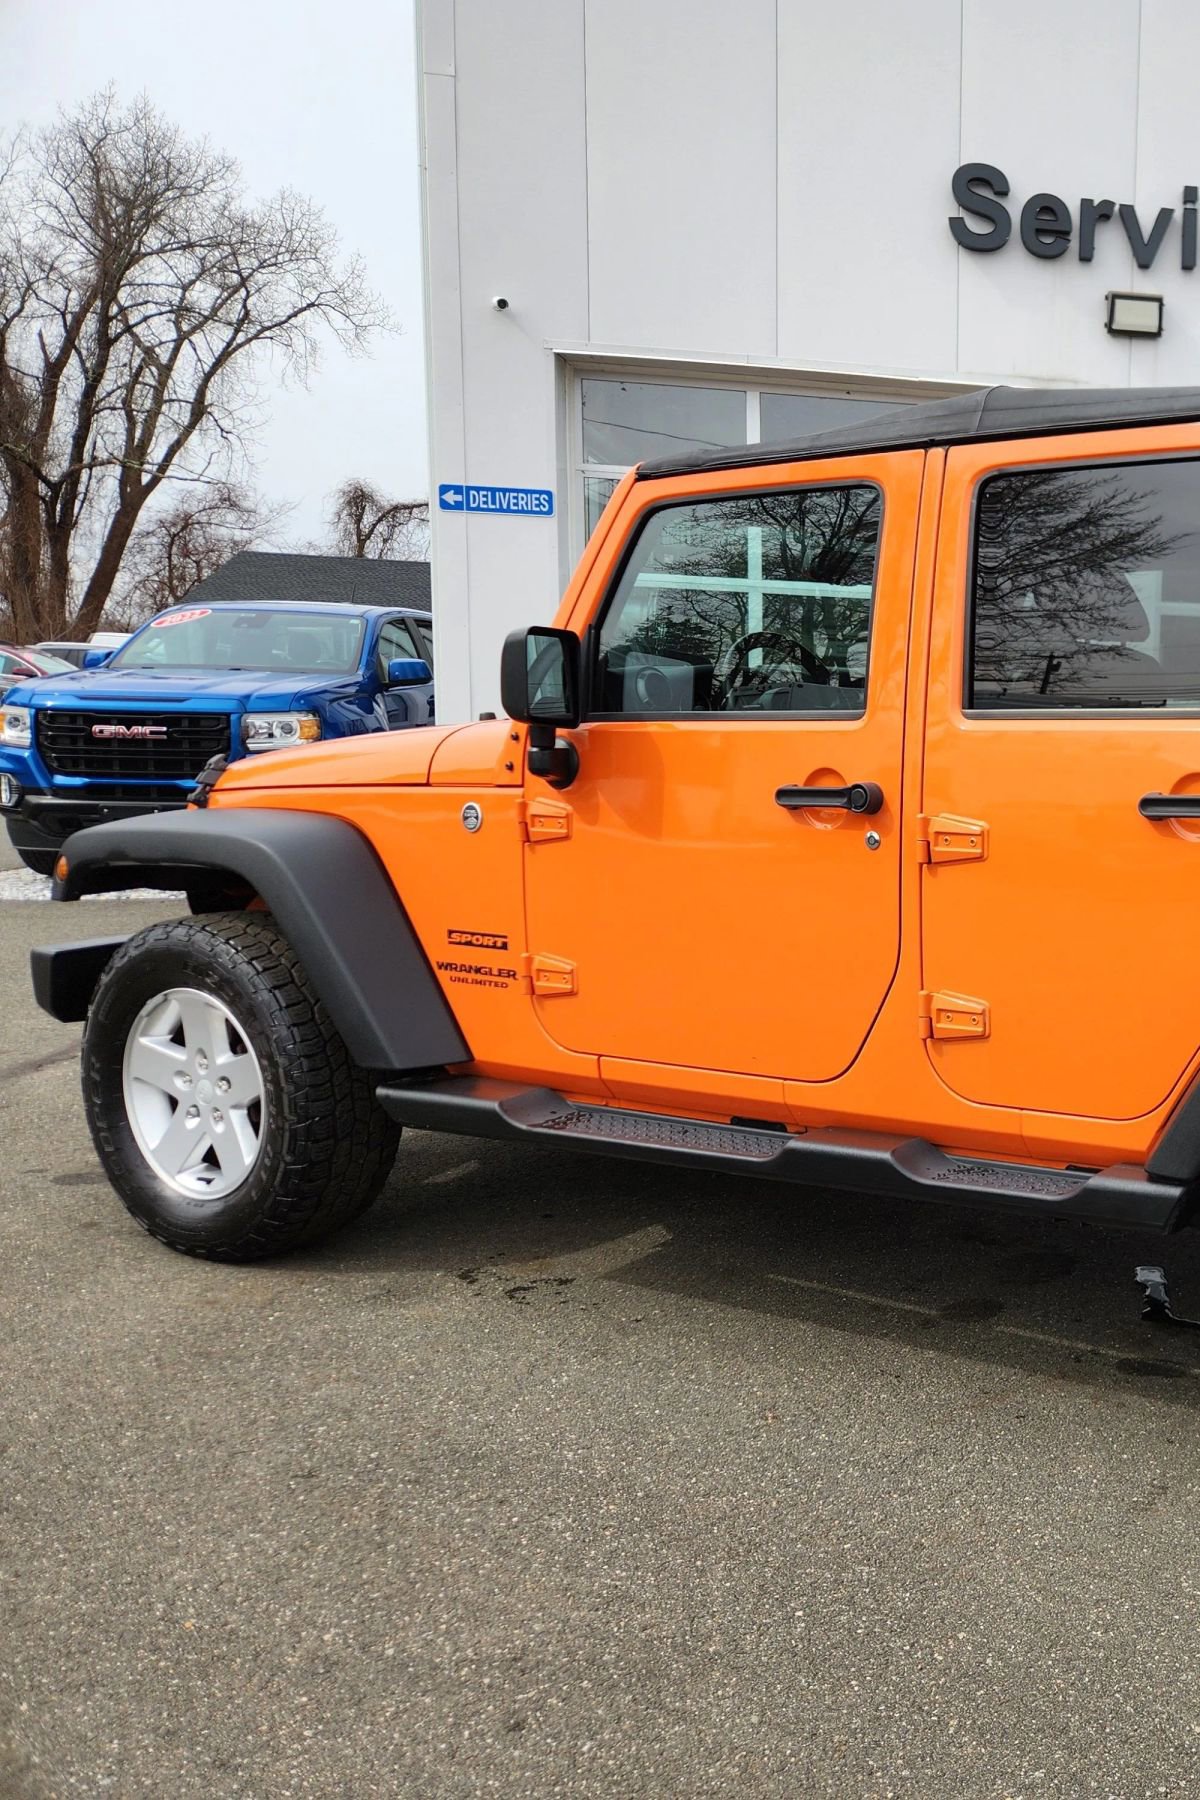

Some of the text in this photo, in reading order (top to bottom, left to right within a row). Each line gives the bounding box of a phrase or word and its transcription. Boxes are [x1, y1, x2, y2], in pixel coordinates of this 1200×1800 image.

[469, 490, 549, 512] DELIVERIES
[92, 725, 167, 739] GMC
[448, 931, 508, 948] SPORT
[436, 961, 519, 981] WRANGLER
[449, 976, 509, 989] UNLIMITED
